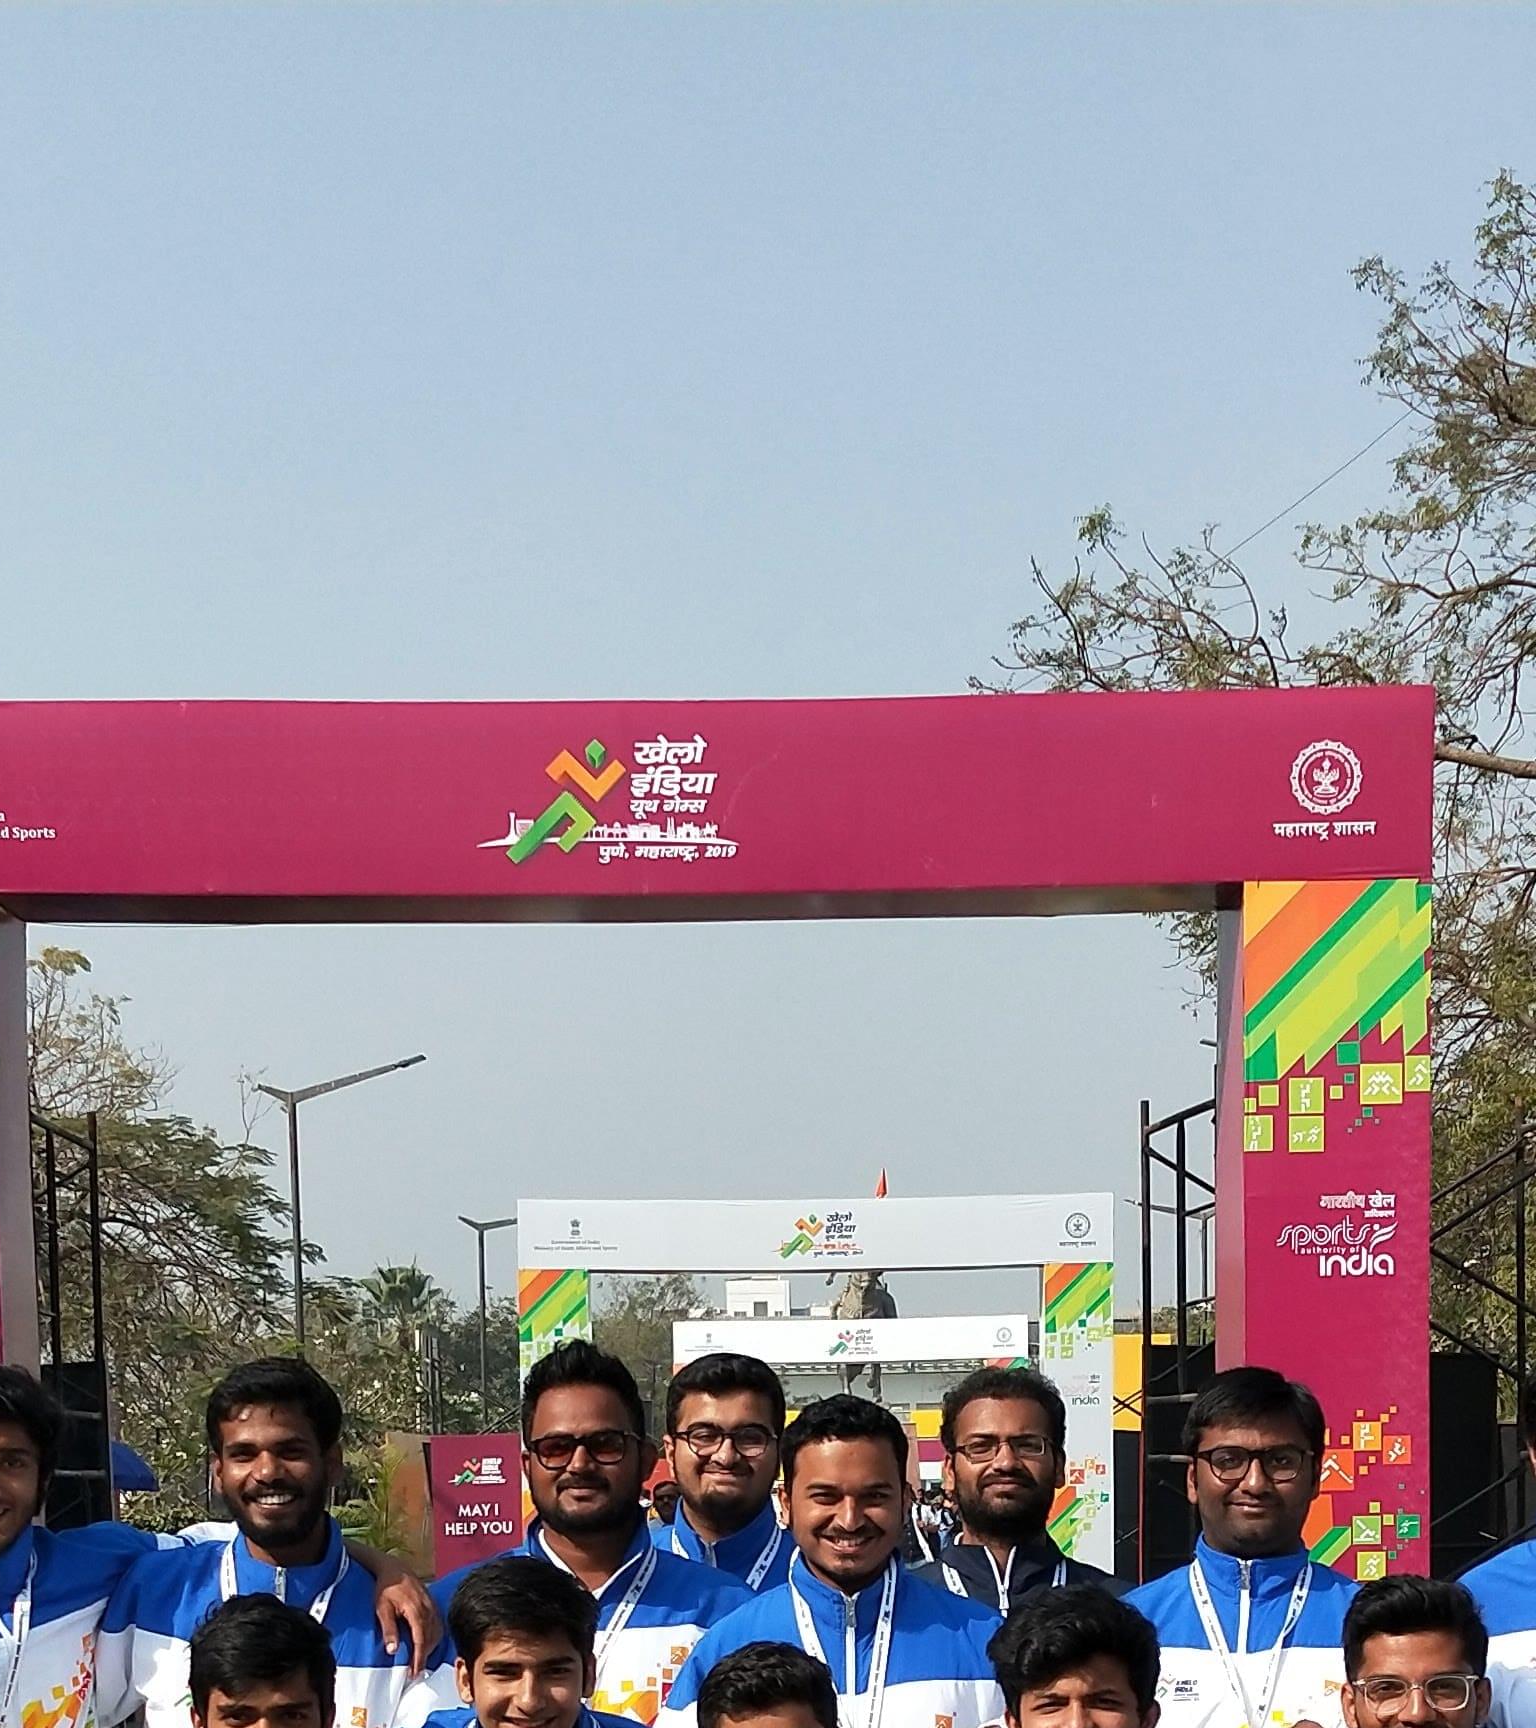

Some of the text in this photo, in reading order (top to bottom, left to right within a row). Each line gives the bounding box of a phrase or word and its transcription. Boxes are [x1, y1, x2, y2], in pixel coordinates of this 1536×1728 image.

[633, 734, 707, 764] खेलो
[630, 766, 718, 797] इंडिया
[630, 795, 708, 819] यूथ गेम्स
[12, 827, 56, 841] Sports
[1273, 821, 1377, 841] महाराष्ट्र शासन
[703, 846, 737, 858] 2019
[1368, 1189, 1396, 1208] खेल
[1276, 1215, 1371, 1255] sports
[1301, 1245, 1360, 1255] authority of
[1319, 1246, 1395, 1277] india
[459, 1503, 499, 1517] MAY I
[445, 1521, 513, 1535] HELP YOU
